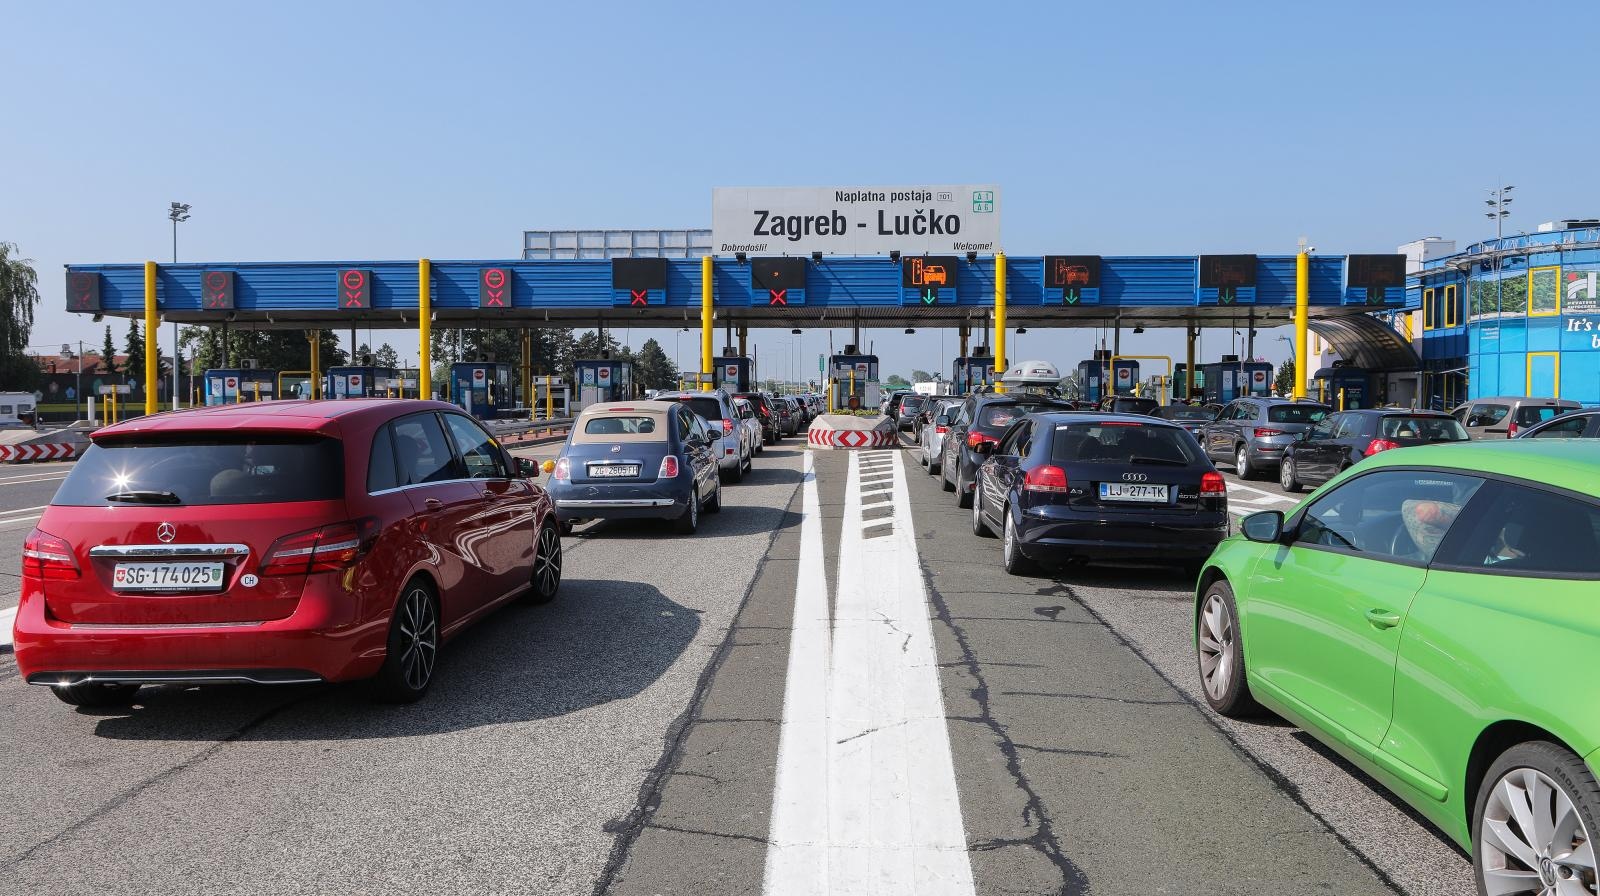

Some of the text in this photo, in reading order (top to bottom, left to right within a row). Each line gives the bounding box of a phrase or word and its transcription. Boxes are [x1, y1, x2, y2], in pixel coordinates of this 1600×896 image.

[835, 189, 932, 204] Naplatna postaja
[753, 209, 847, 242] Zagreb
[877, 208, 961, 236] Lučko
[721, 243, 767, 252] Dobrodošli!
[953, 241, 993, 251] Welcome!
[1109, 485, 1164, 498] LJ 277-TK
[244, 576, 255, 585] CH
